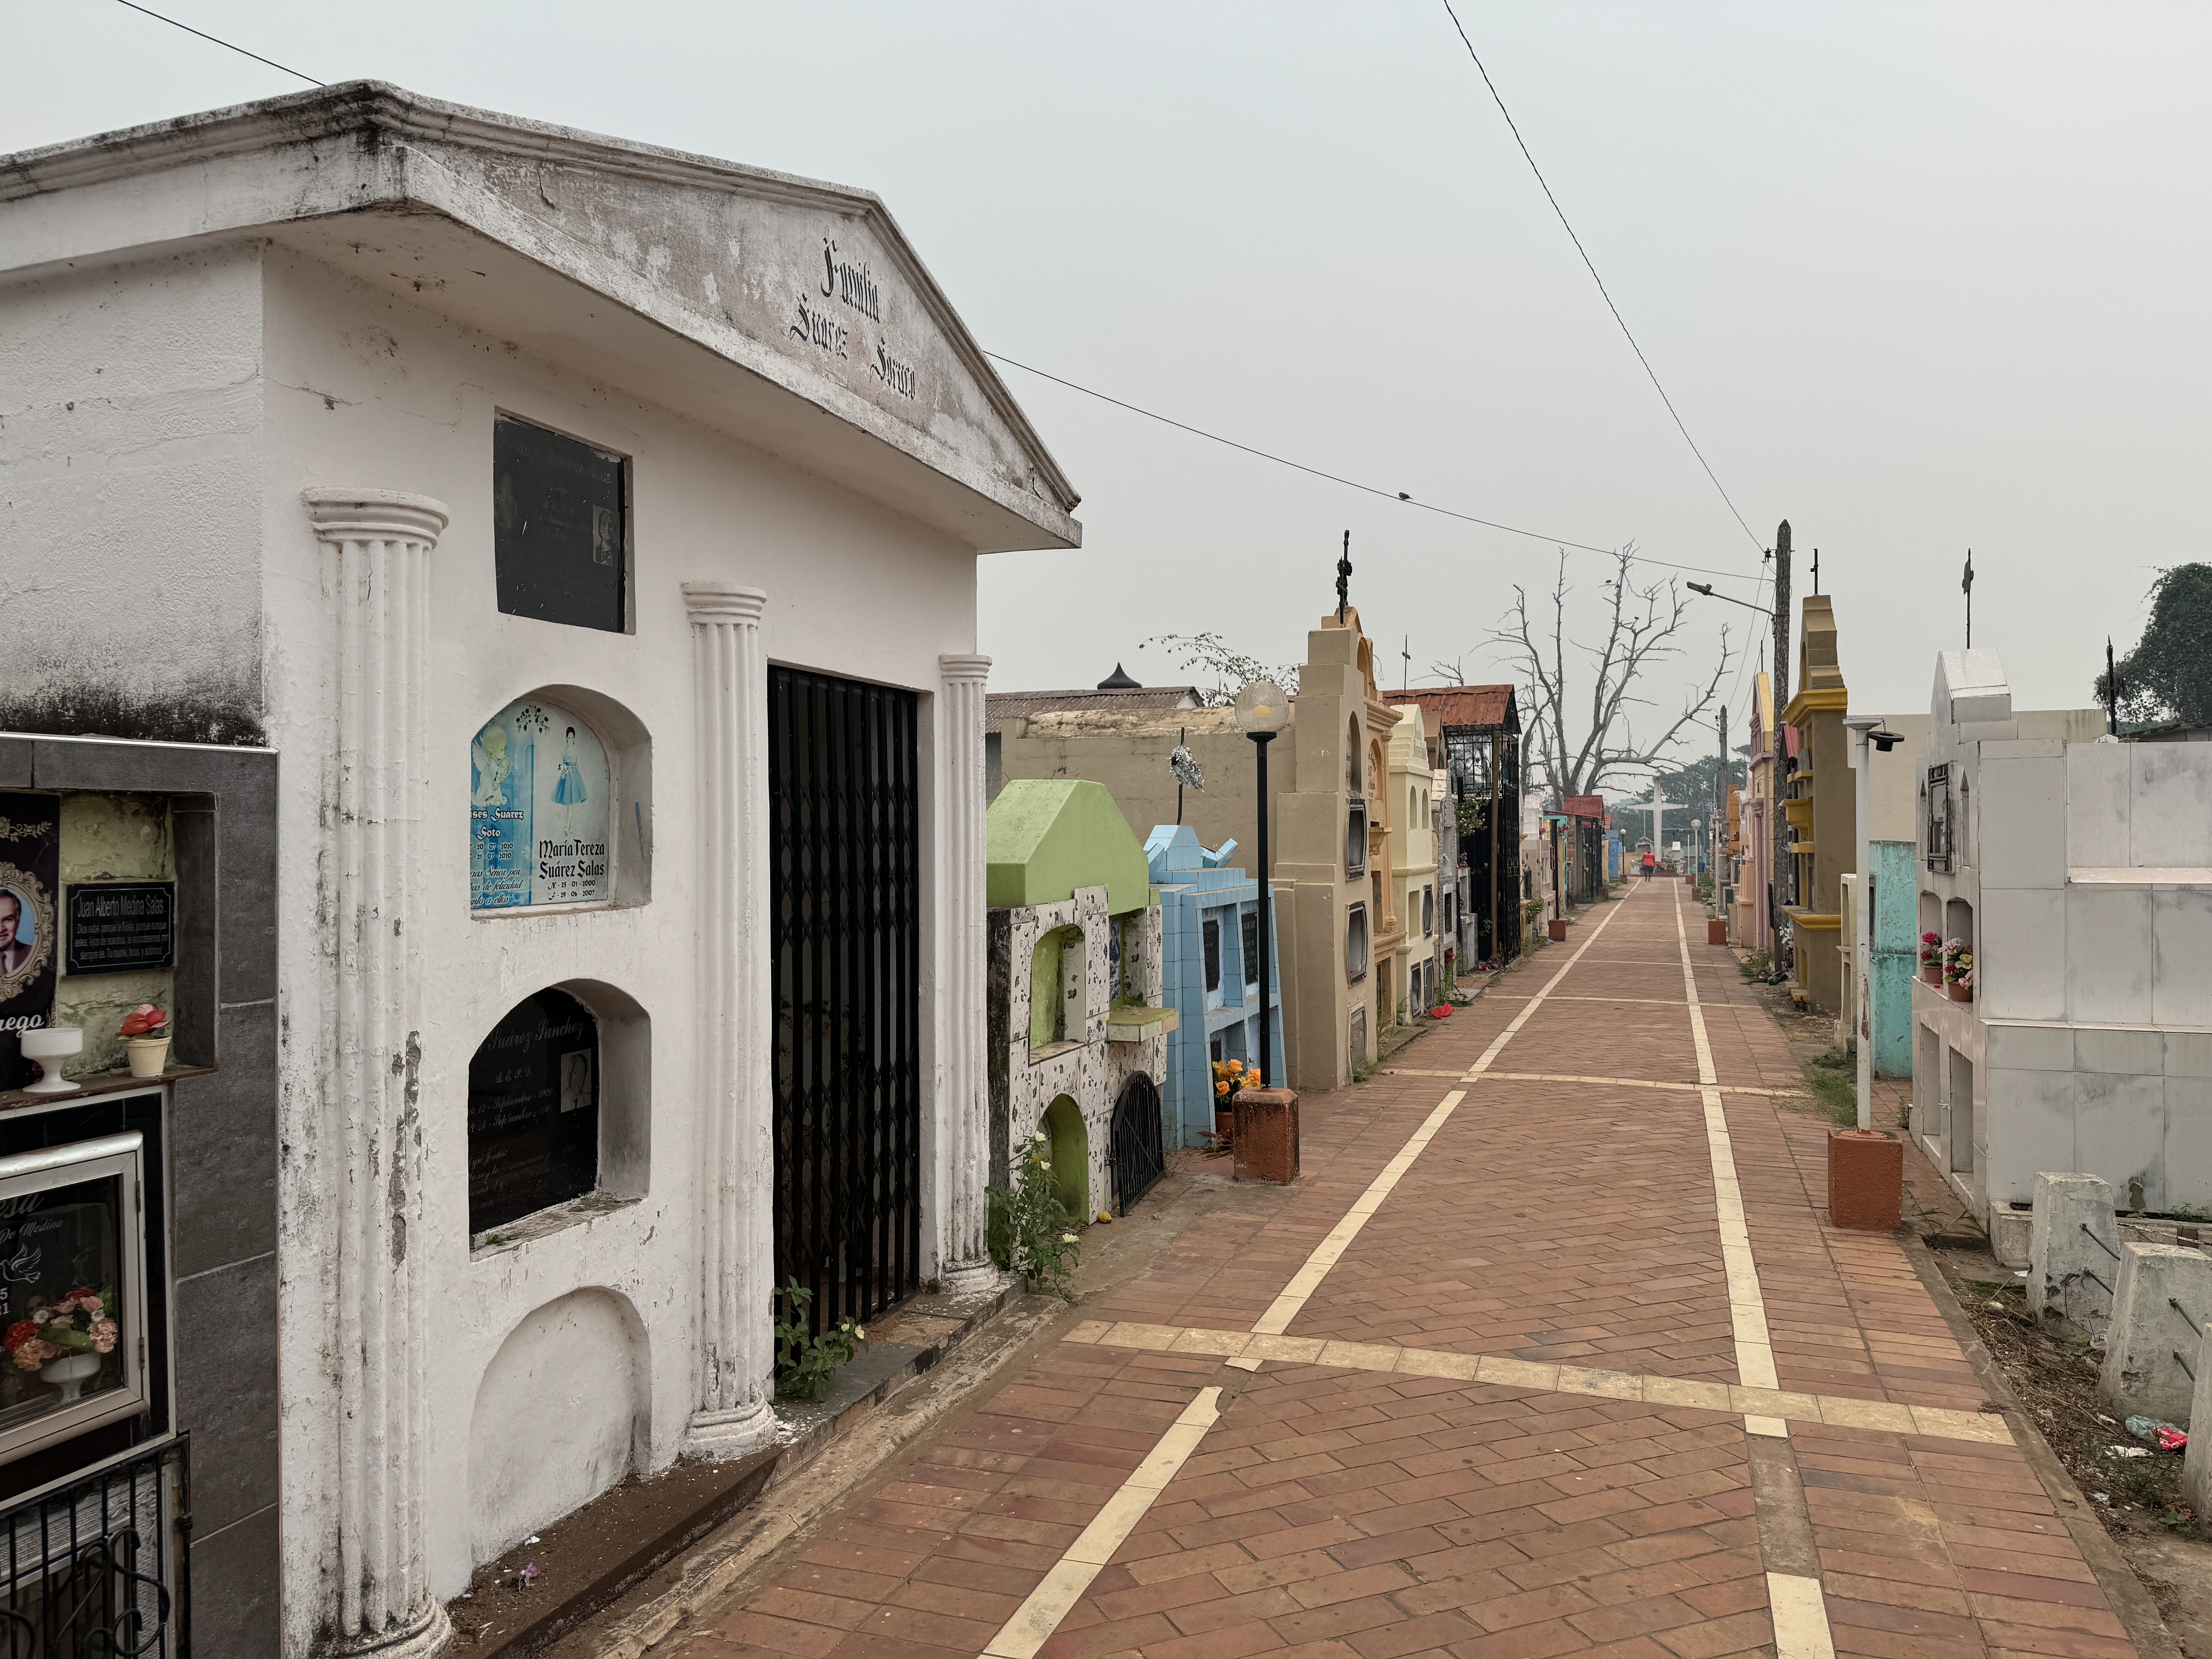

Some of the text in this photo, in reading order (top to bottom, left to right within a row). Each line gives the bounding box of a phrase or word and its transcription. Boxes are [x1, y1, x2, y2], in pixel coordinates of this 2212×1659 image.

[821, 237, 880, 323] Familia
[790, 292, 915, 400] Suarez Soruco
[490, 807, 524, 822] Suárez
[476, 826, 501, 840] Soto
[539, 838, 605, 859] María Tereza
[505, 869, 521, 879] por
[539, 859, 604, 879] Suárez Salas
[483, 881, 492, 891] de
[489, 879, 524, 893] felicidad
[77, 894, 163, 917] Juan Alberto Medina Salas
[494, 894, 509, 903] ellos
[0, 1014, 45, 1038] ego
[19, 1218, 63, 1236] Medina
